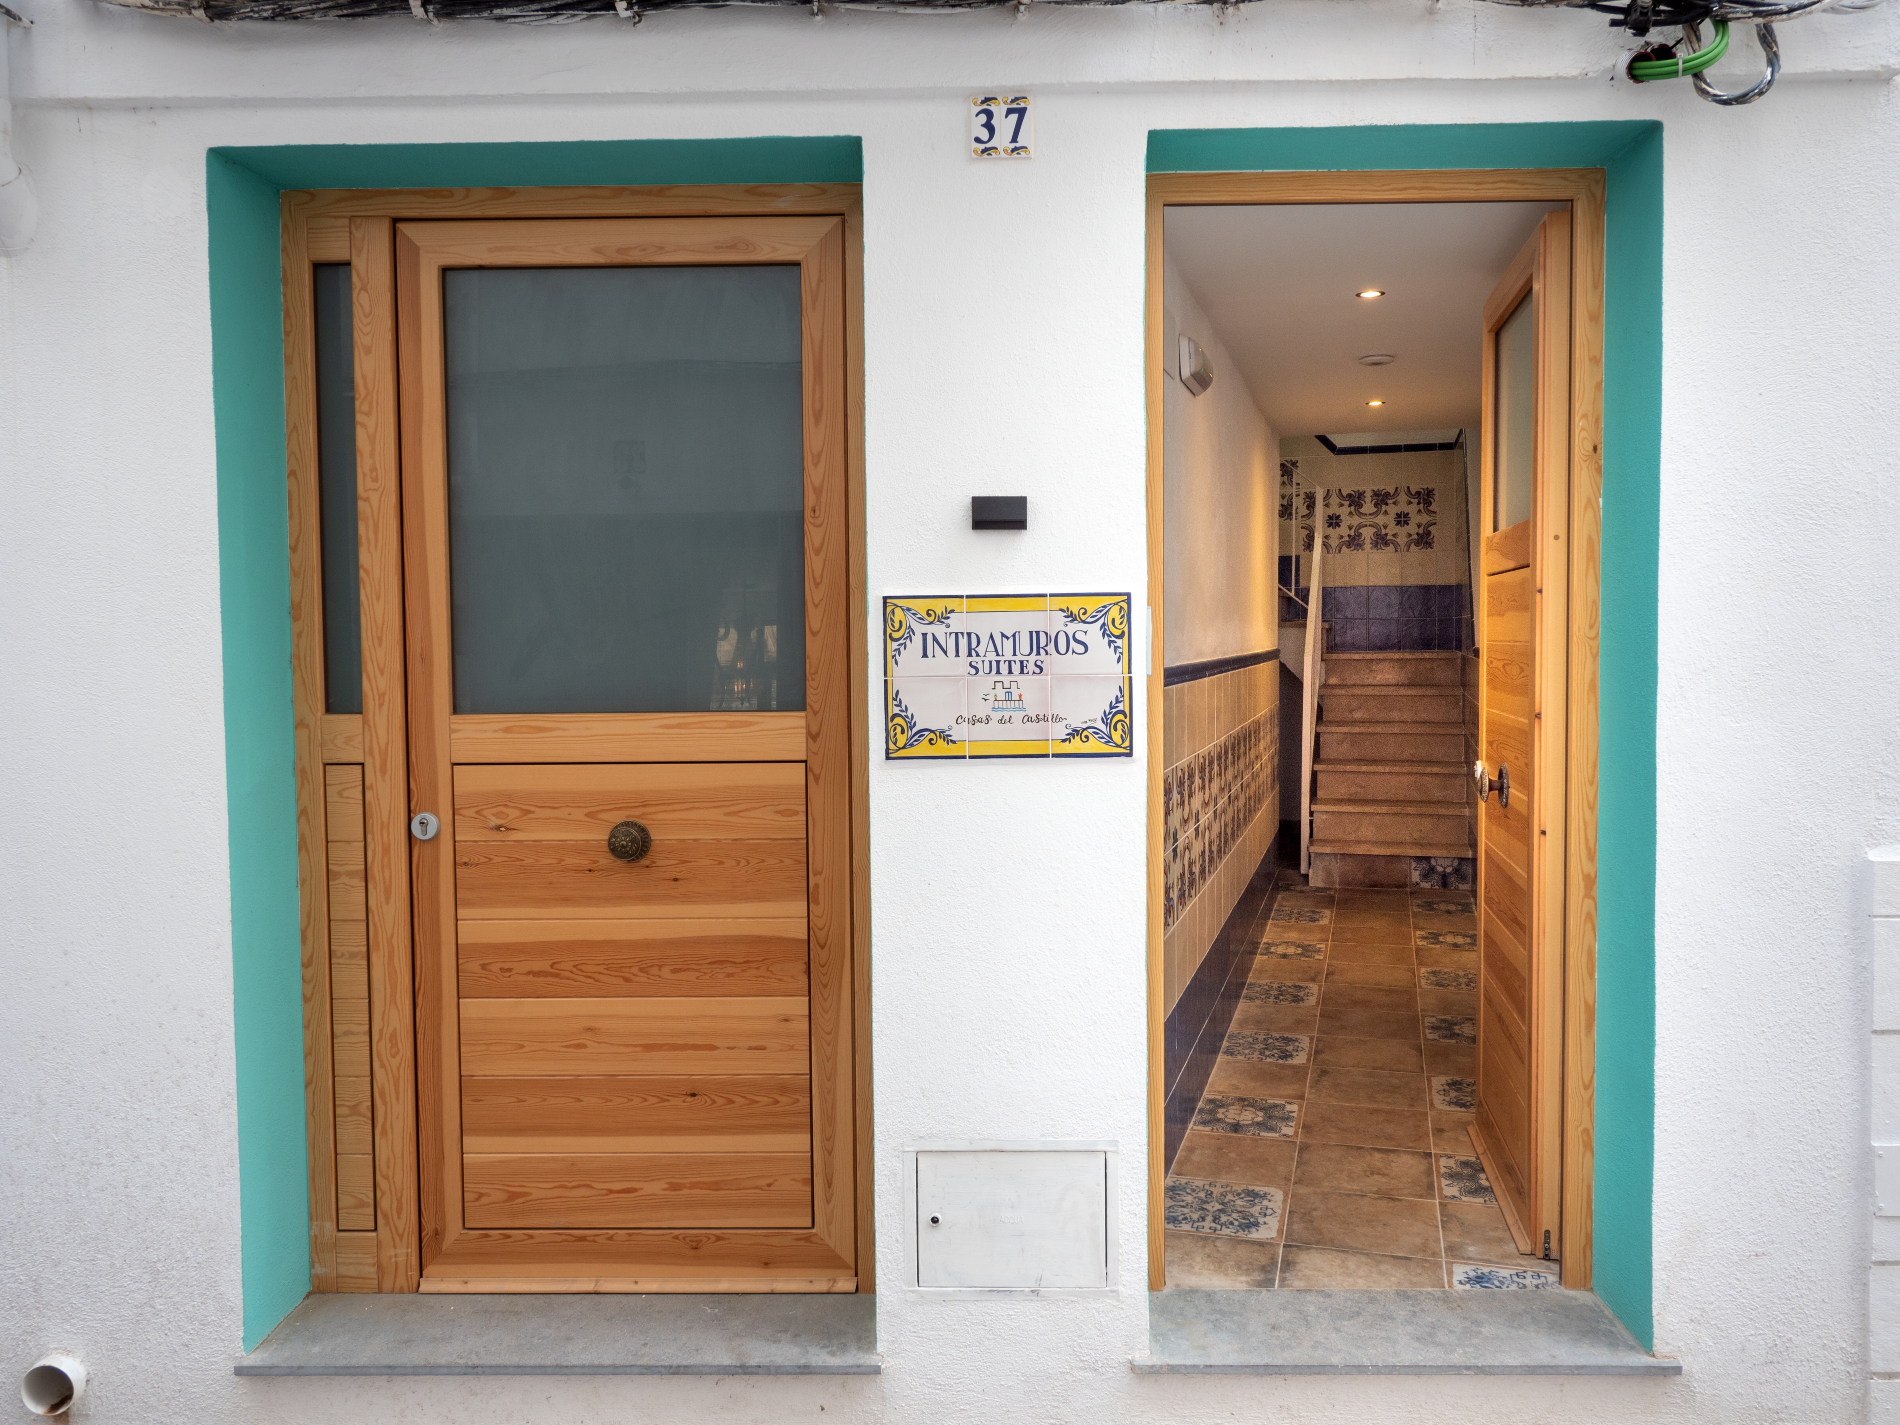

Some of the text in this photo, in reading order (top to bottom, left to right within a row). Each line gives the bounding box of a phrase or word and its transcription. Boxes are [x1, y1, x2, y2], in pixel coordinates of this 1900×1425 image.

[973, 106, 1028, 145] 37
[921, 629, 1088, 658] INTRAMUROS
[967, 659, 1045, 676] SUITES
[955, 714, 992, 726] Casas
[998, 714, 1014, 724] del
[1021, 712, 1068, 725] Castillo
[999, 1214, 1025, 1225] ACQUA
